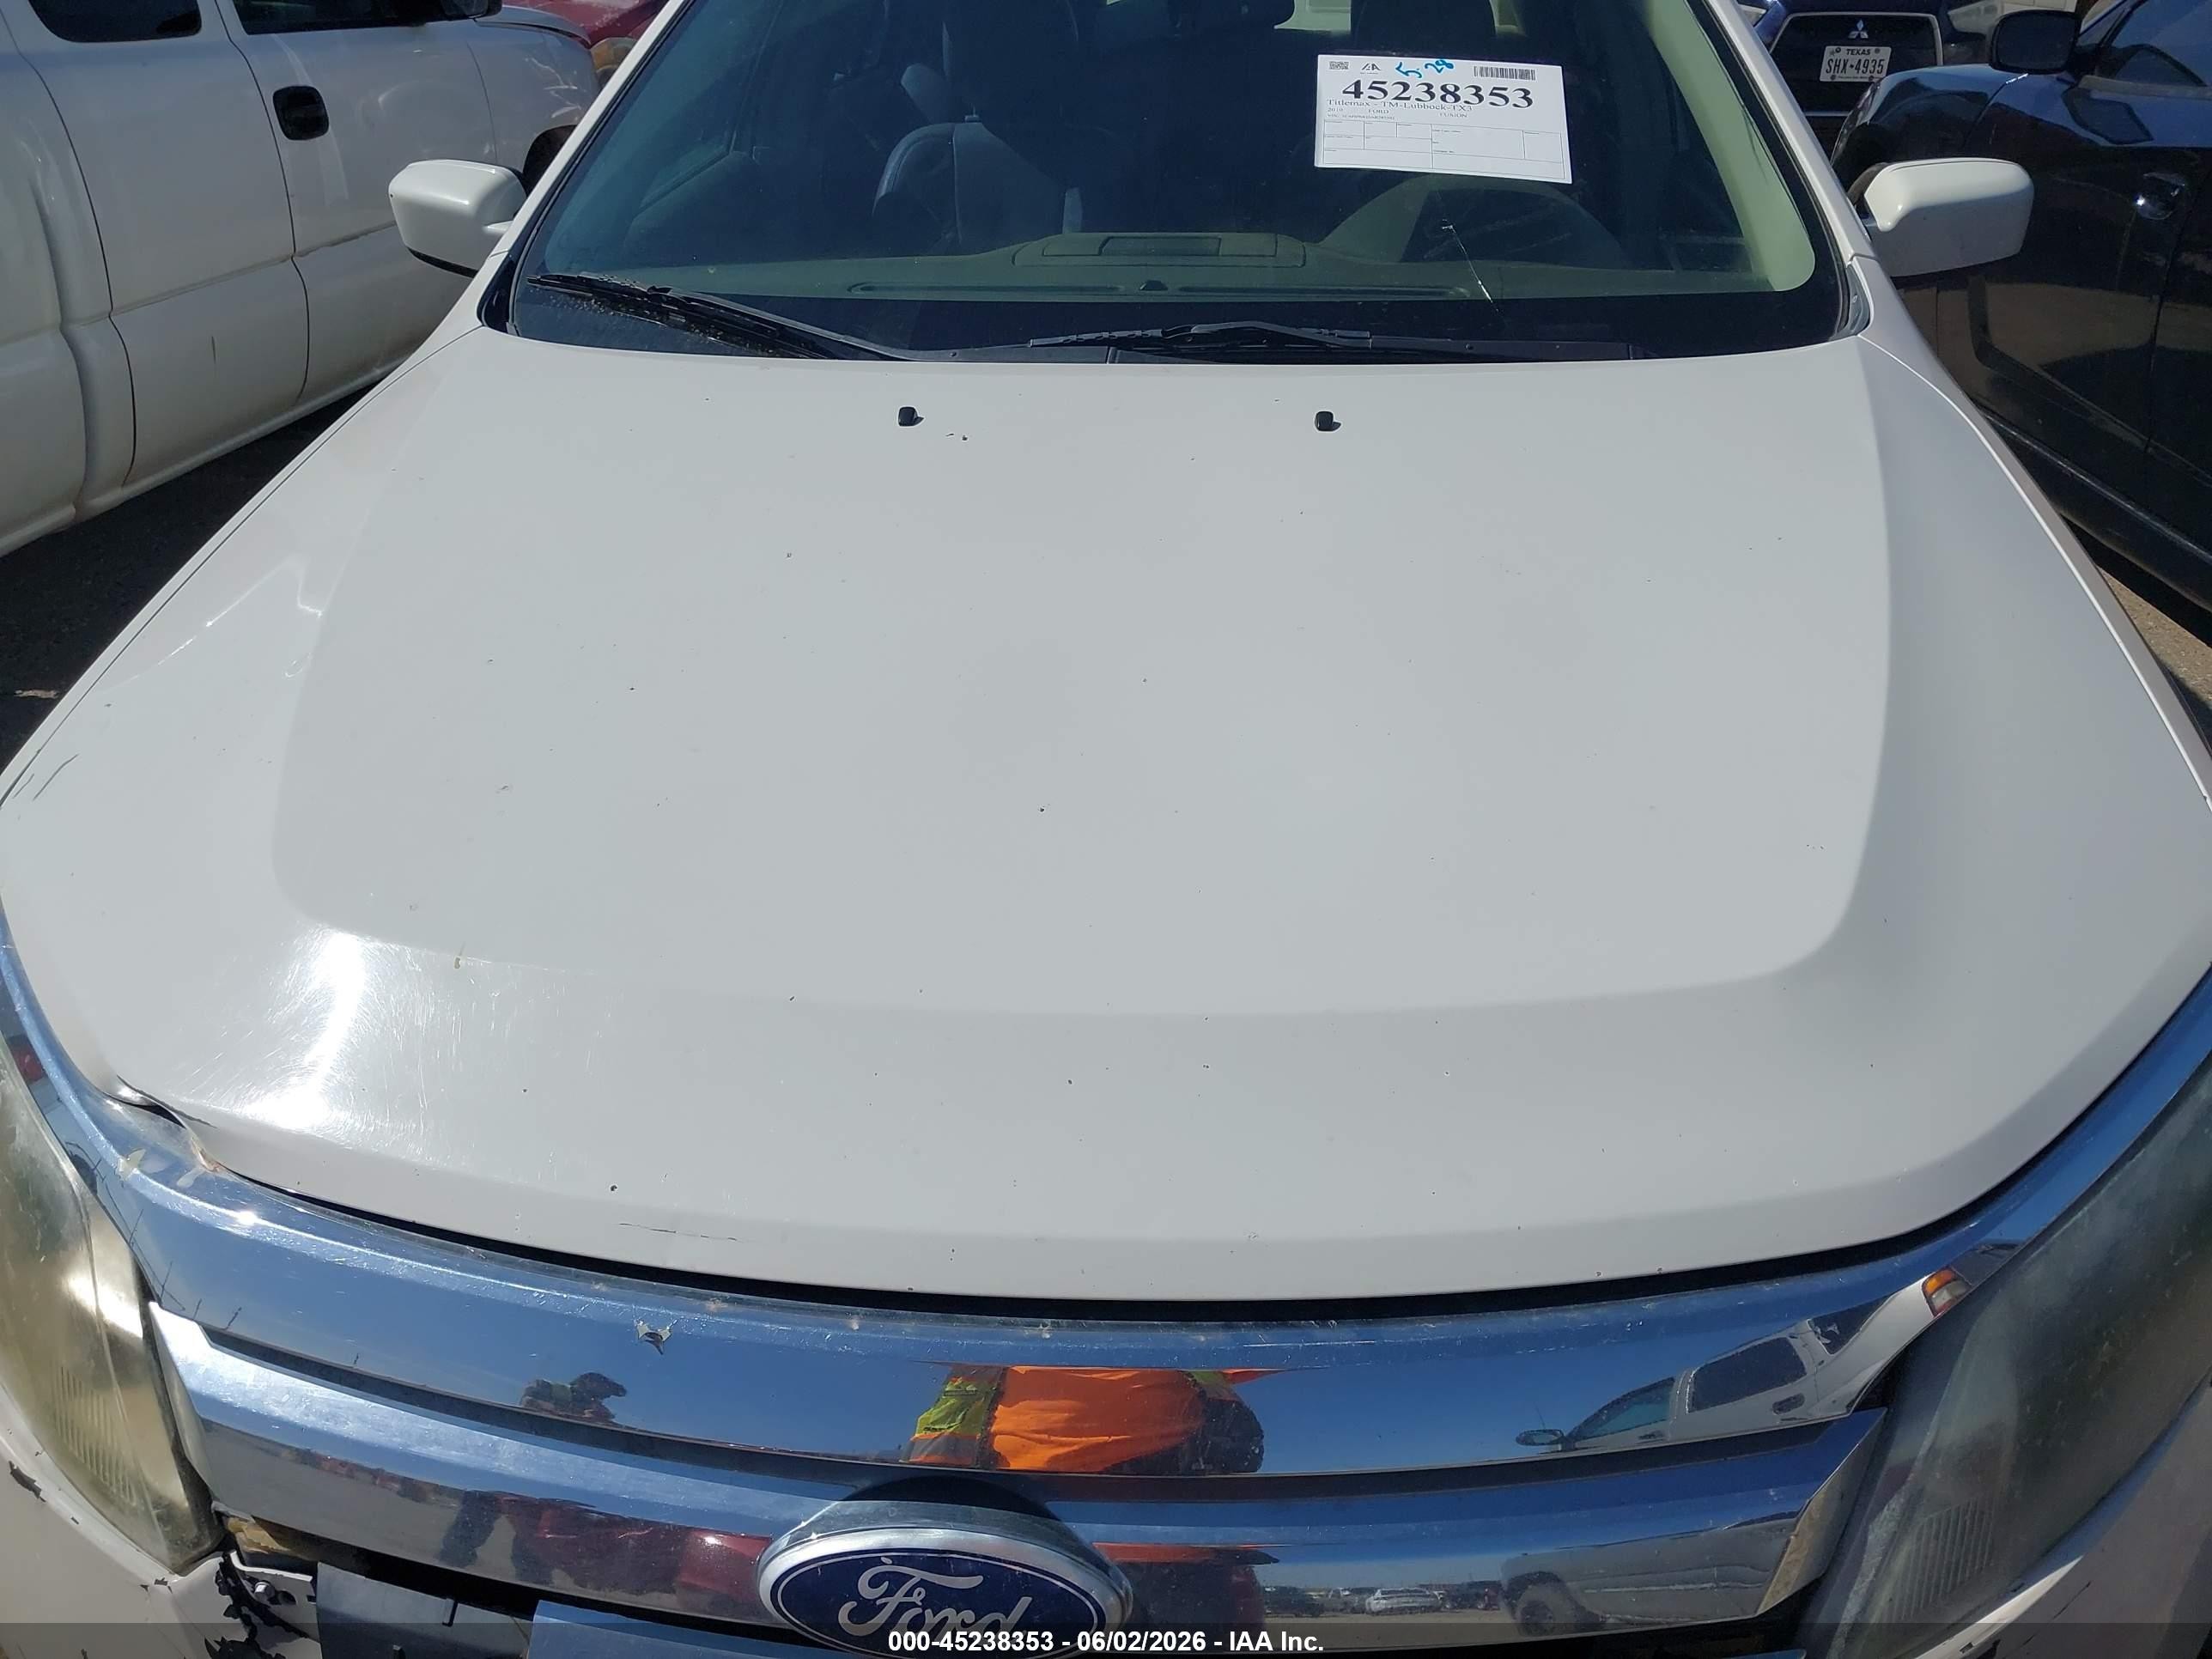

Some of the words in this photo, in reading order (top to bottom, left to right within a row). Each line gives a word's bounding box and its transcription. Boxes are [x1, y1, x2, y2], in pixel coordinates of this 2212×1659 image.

[1327, 99, 1371, 107] Titlemax
[1342, 79, 1534, 109] 45238353
[838, 1556, 1032, 1638] Ford
